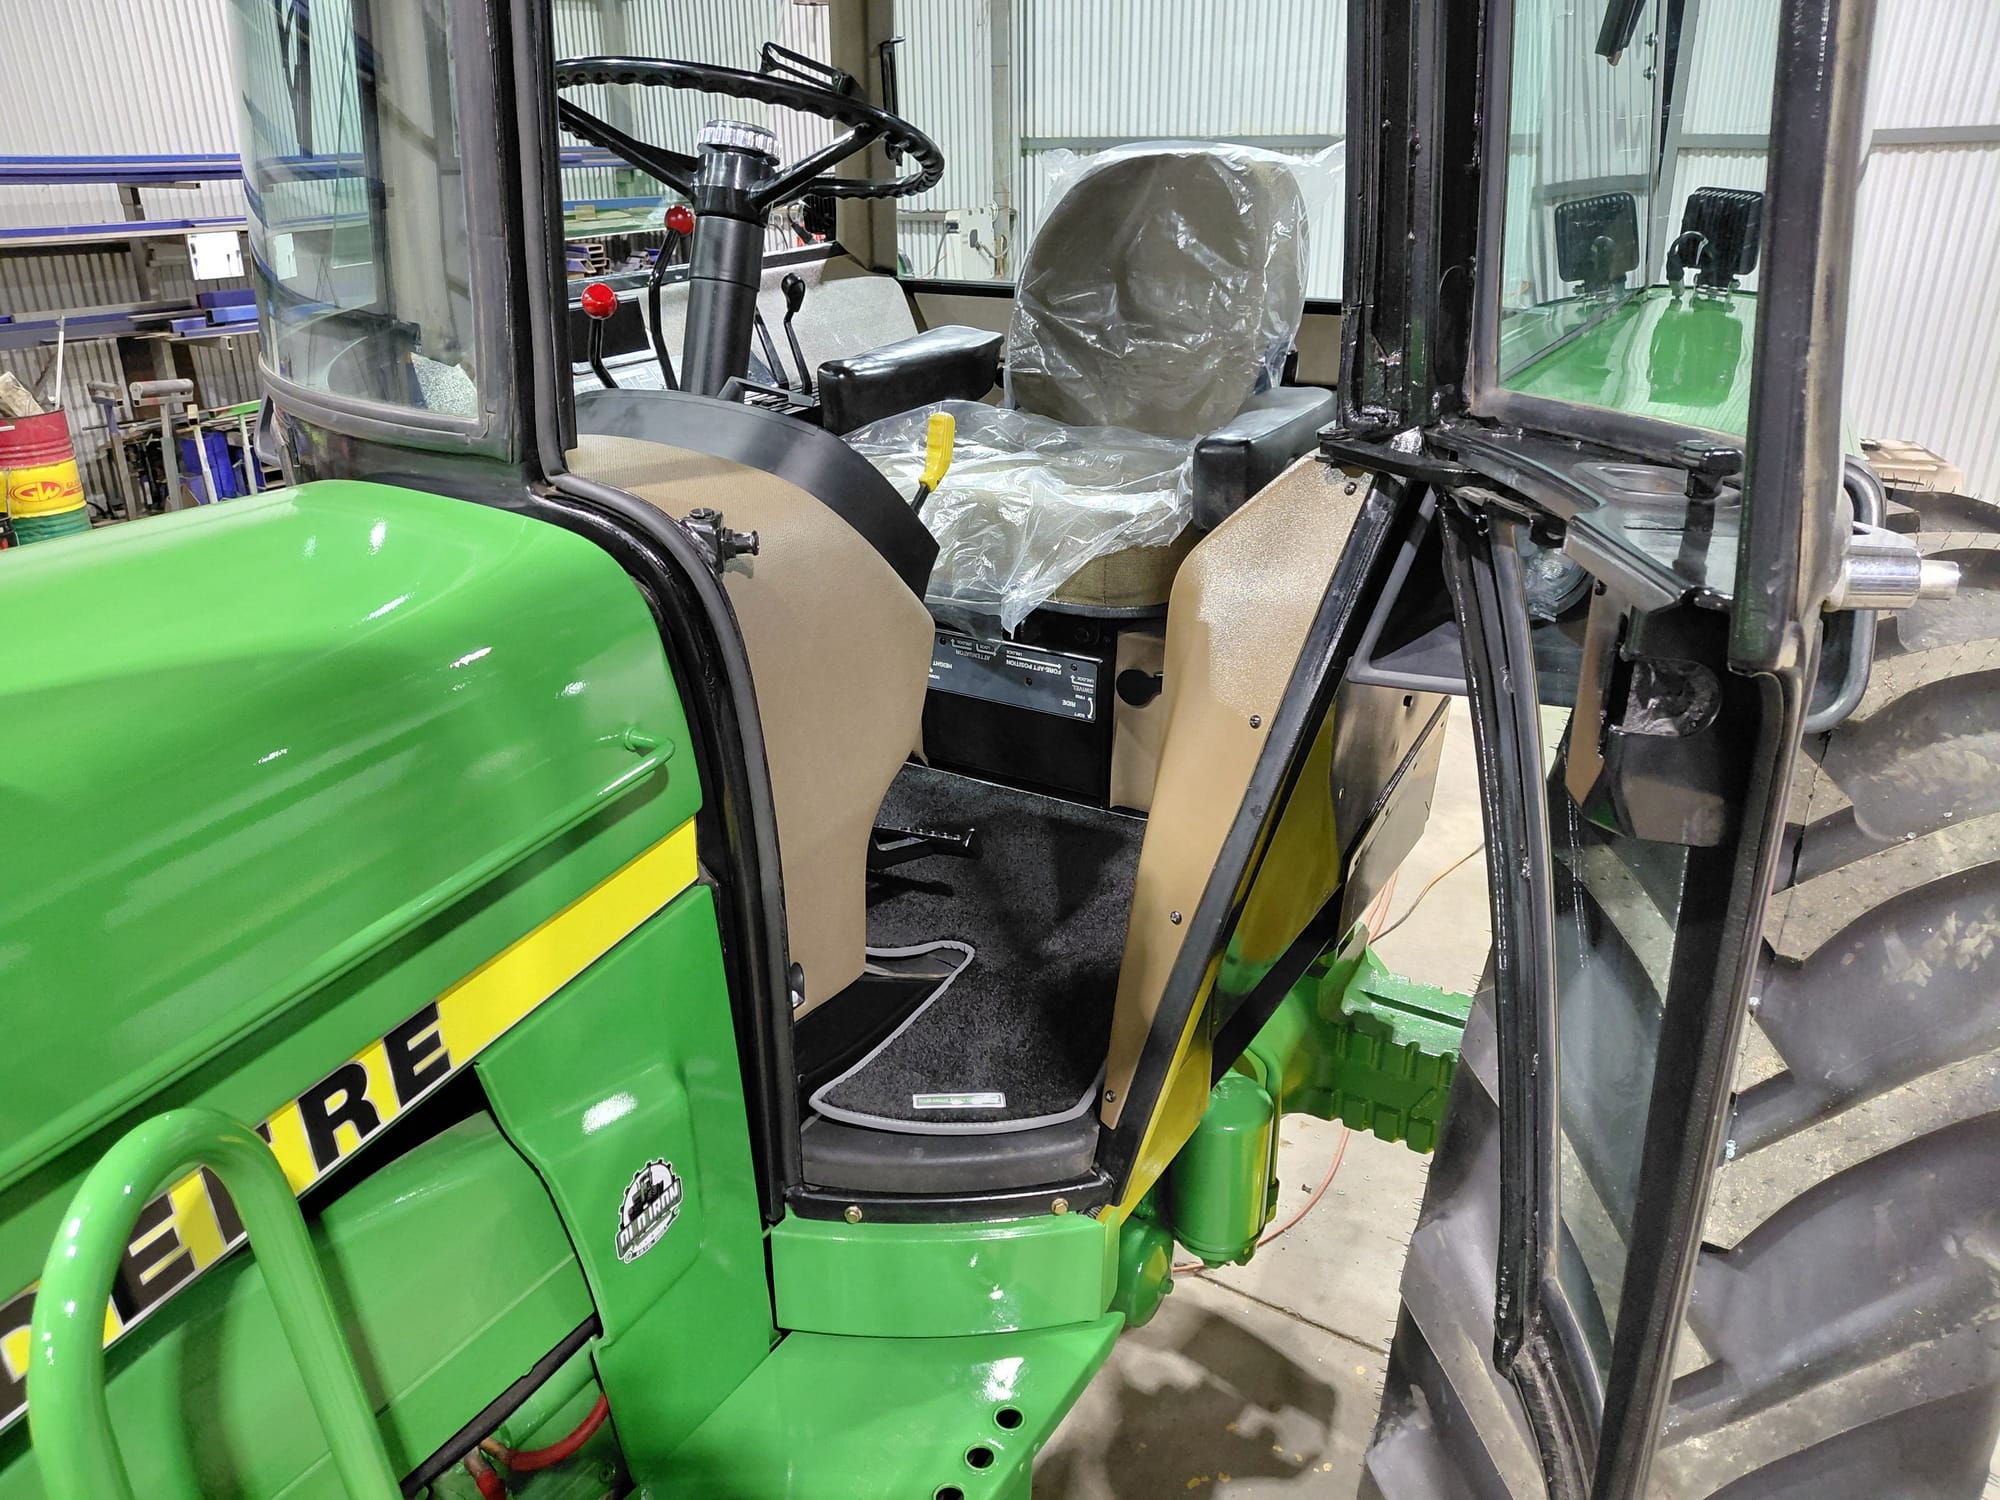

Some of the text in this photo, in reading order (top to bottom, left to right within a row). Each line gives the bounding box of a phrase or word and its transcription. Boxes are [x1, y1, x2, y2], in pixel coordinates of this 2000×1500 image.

[955, 649, 991, 661] ATTENUATOR
[932, 661, 953, 670] HEIGHT
[1006, 659, 1033, 671] POSITION
[1072, 684, 1094, 694] SWIVEL
[1062, 700, 1077, 708] RIDE
